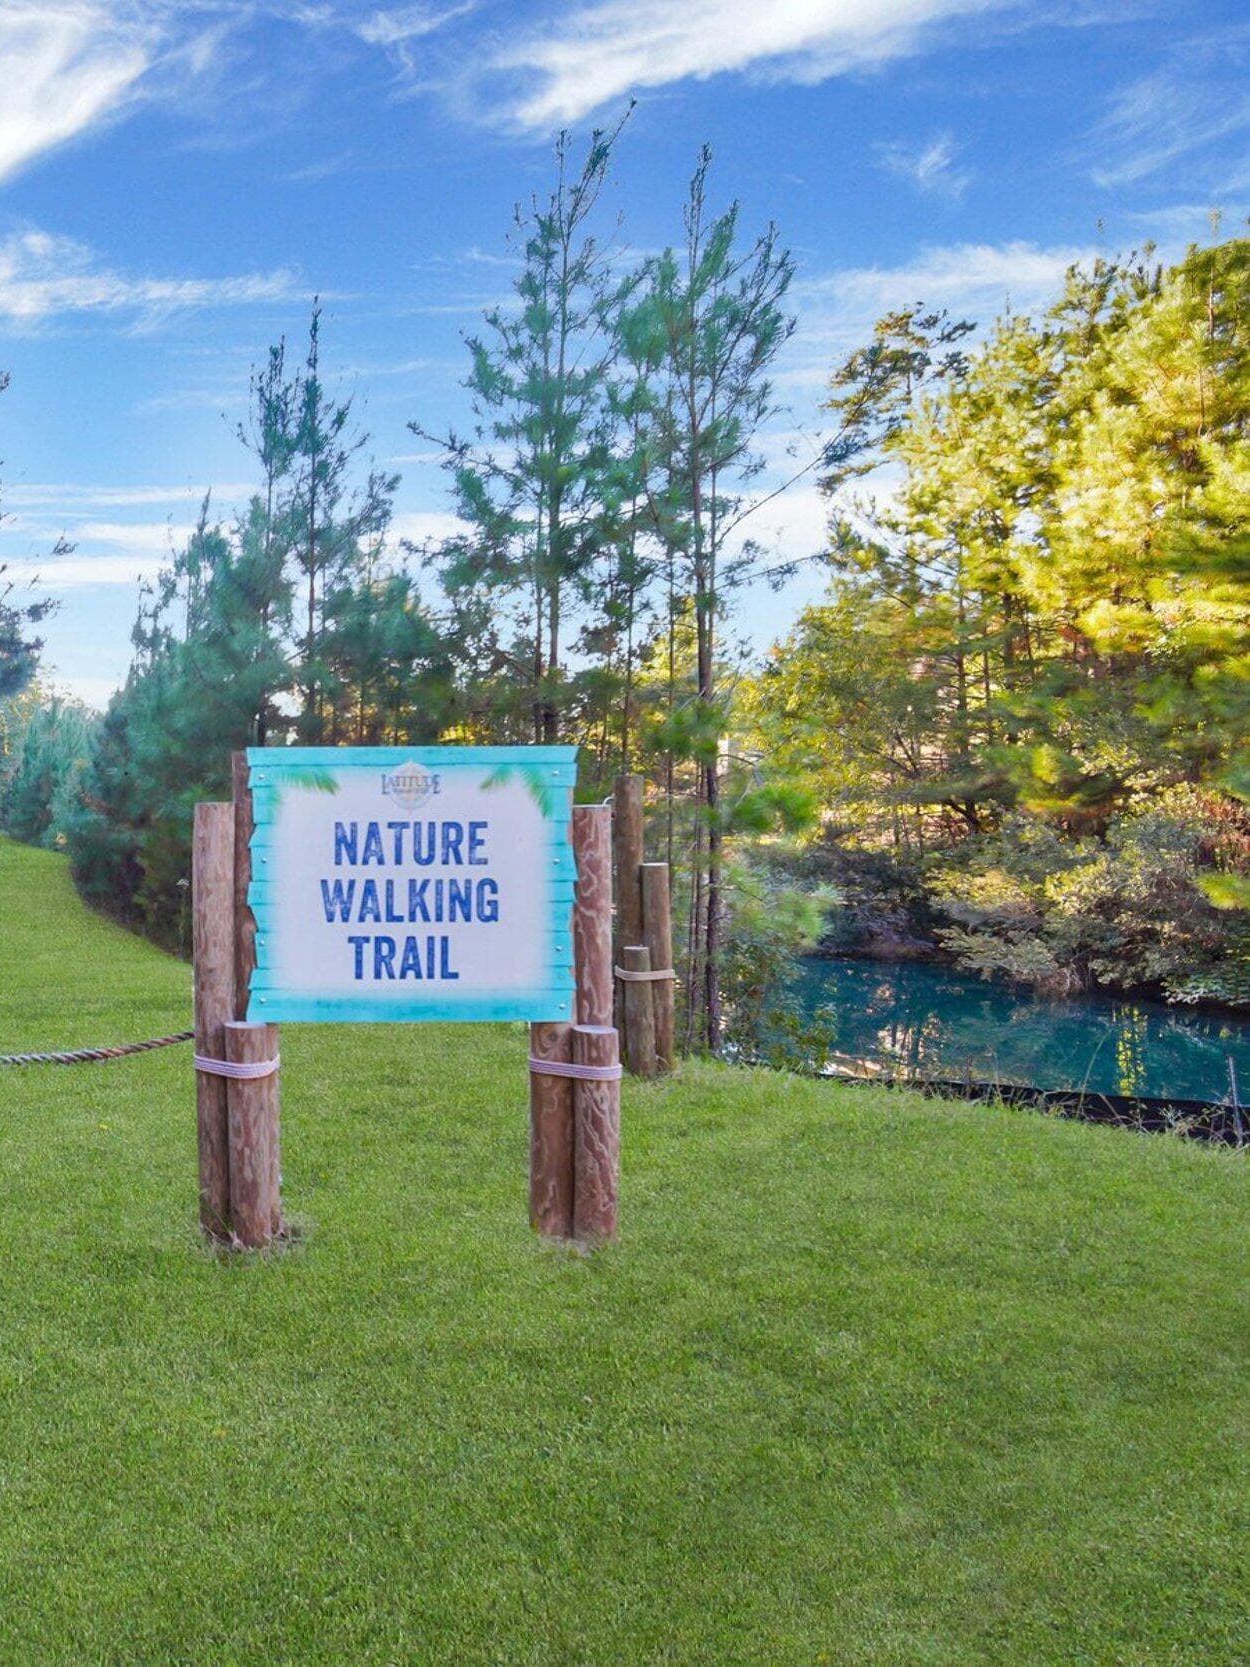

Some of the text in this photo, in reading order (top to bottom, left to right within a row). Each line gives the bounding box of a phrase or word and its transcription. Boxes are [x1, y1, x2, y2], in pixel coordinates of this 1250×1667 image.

[333, 821, 489, 866] NATURE
[319, 878, 500, 923] WALKING
[346, 935, 460, 980] TRAIL
